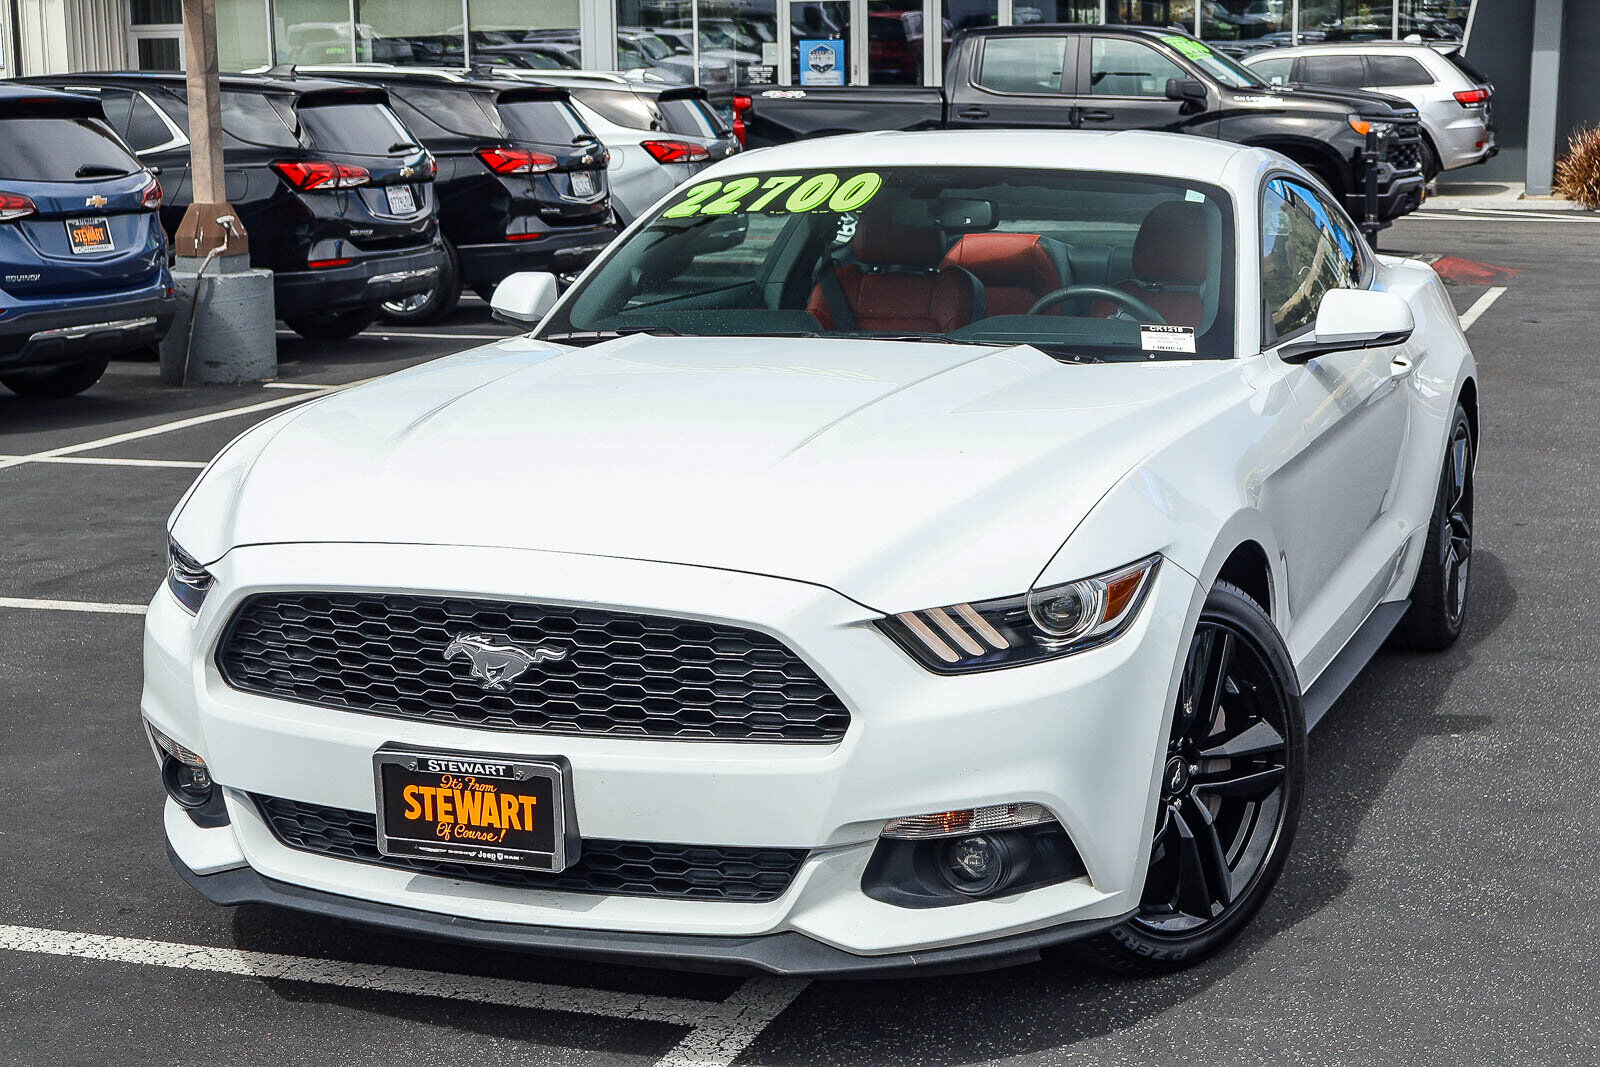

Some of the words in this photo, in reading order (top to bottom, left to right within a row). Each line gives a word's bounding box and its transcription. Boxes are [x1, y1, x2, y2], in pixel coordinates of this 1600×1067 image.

[662, 172, 883, 218] 22700
[73, 227, 105, 243] STEWART
[428, 759, 506, 776] STEWART
[440, 774, 463, 790] It's
[465, 777, 498, 792] From
[403, 784, 537, 832] STEWART
[436, 822, 453, 842] Of
[478, 850, 496, 861] Jeep
